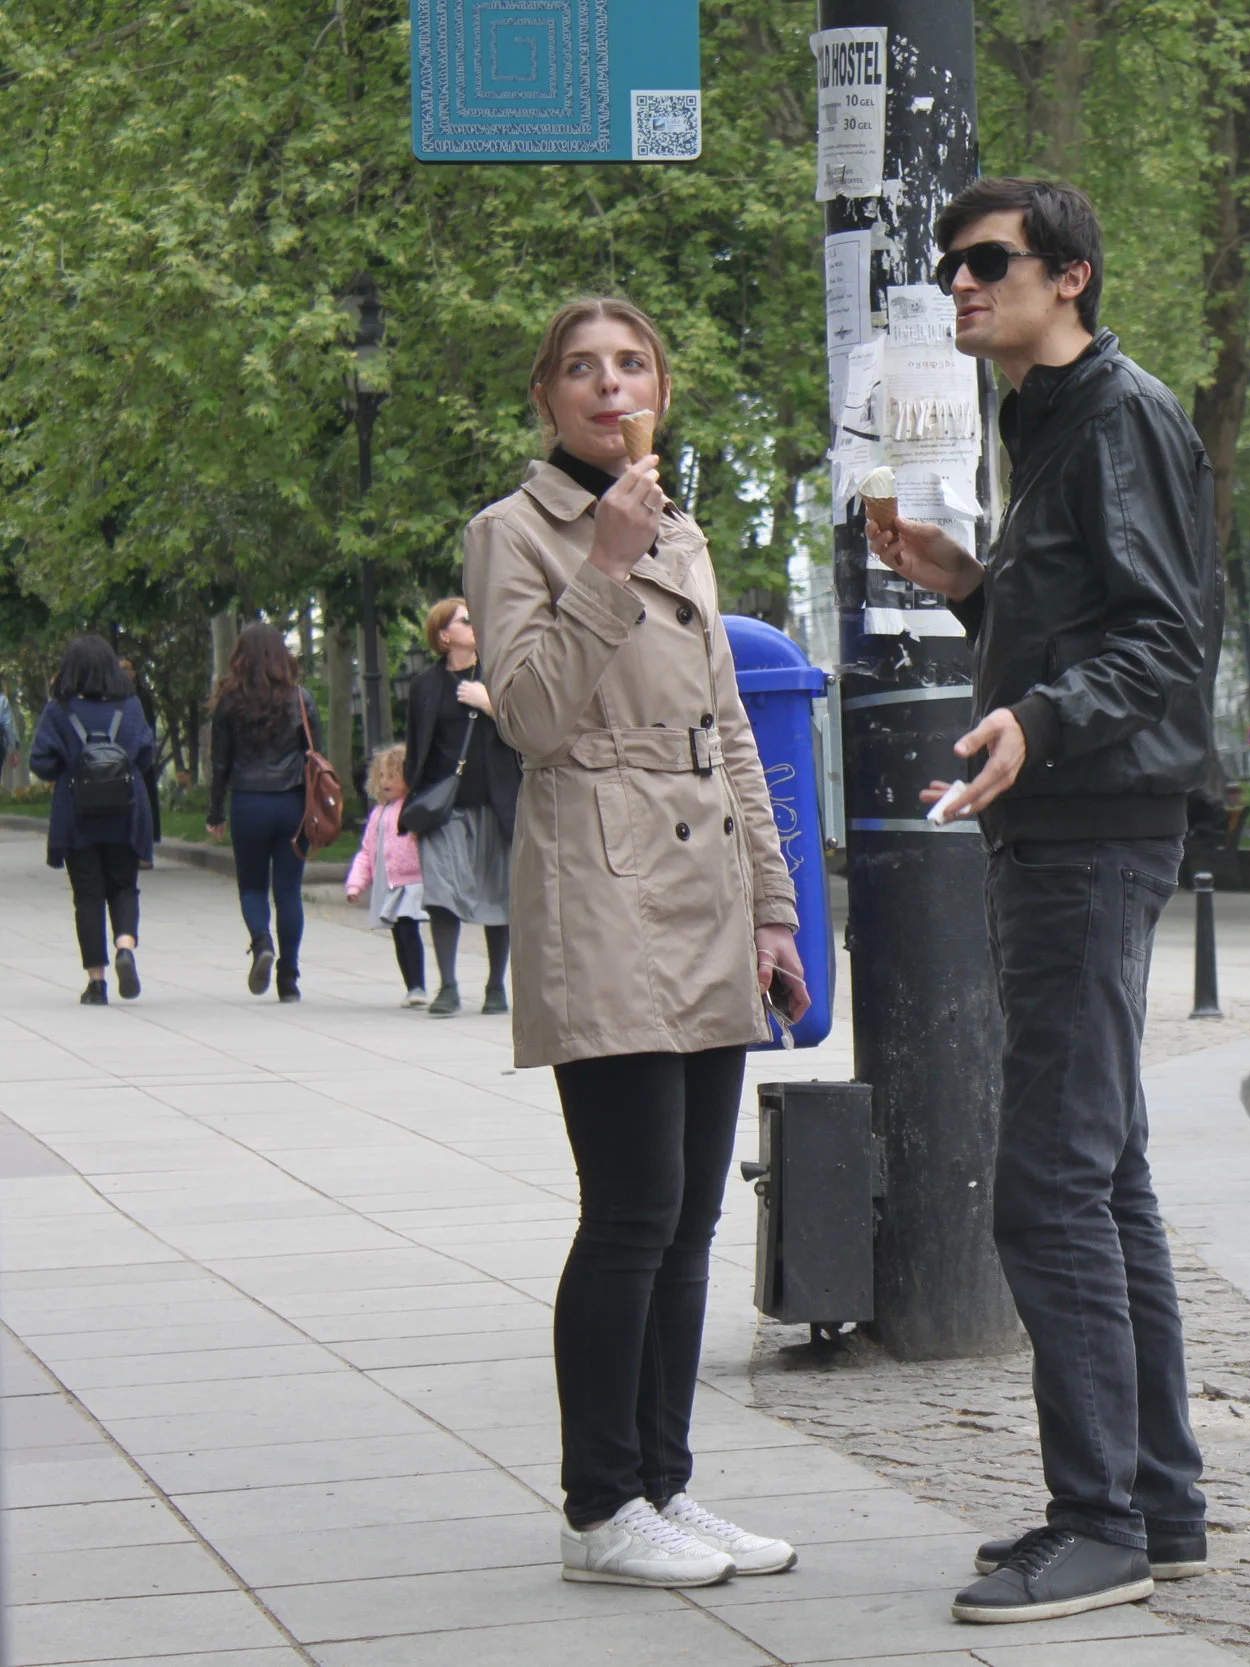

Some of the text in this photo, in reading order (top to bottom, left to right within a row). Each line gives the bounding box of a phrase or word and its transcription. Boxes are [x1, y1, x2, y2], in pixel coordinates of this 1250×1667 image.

[832, 41, 882, 87] HOSTEL
[846, 94, 859, 107] 10
[860, 98, 875, 107] GEL
[843, 118, 857, 131] 30
[858, 121, 873, 130] GEL
